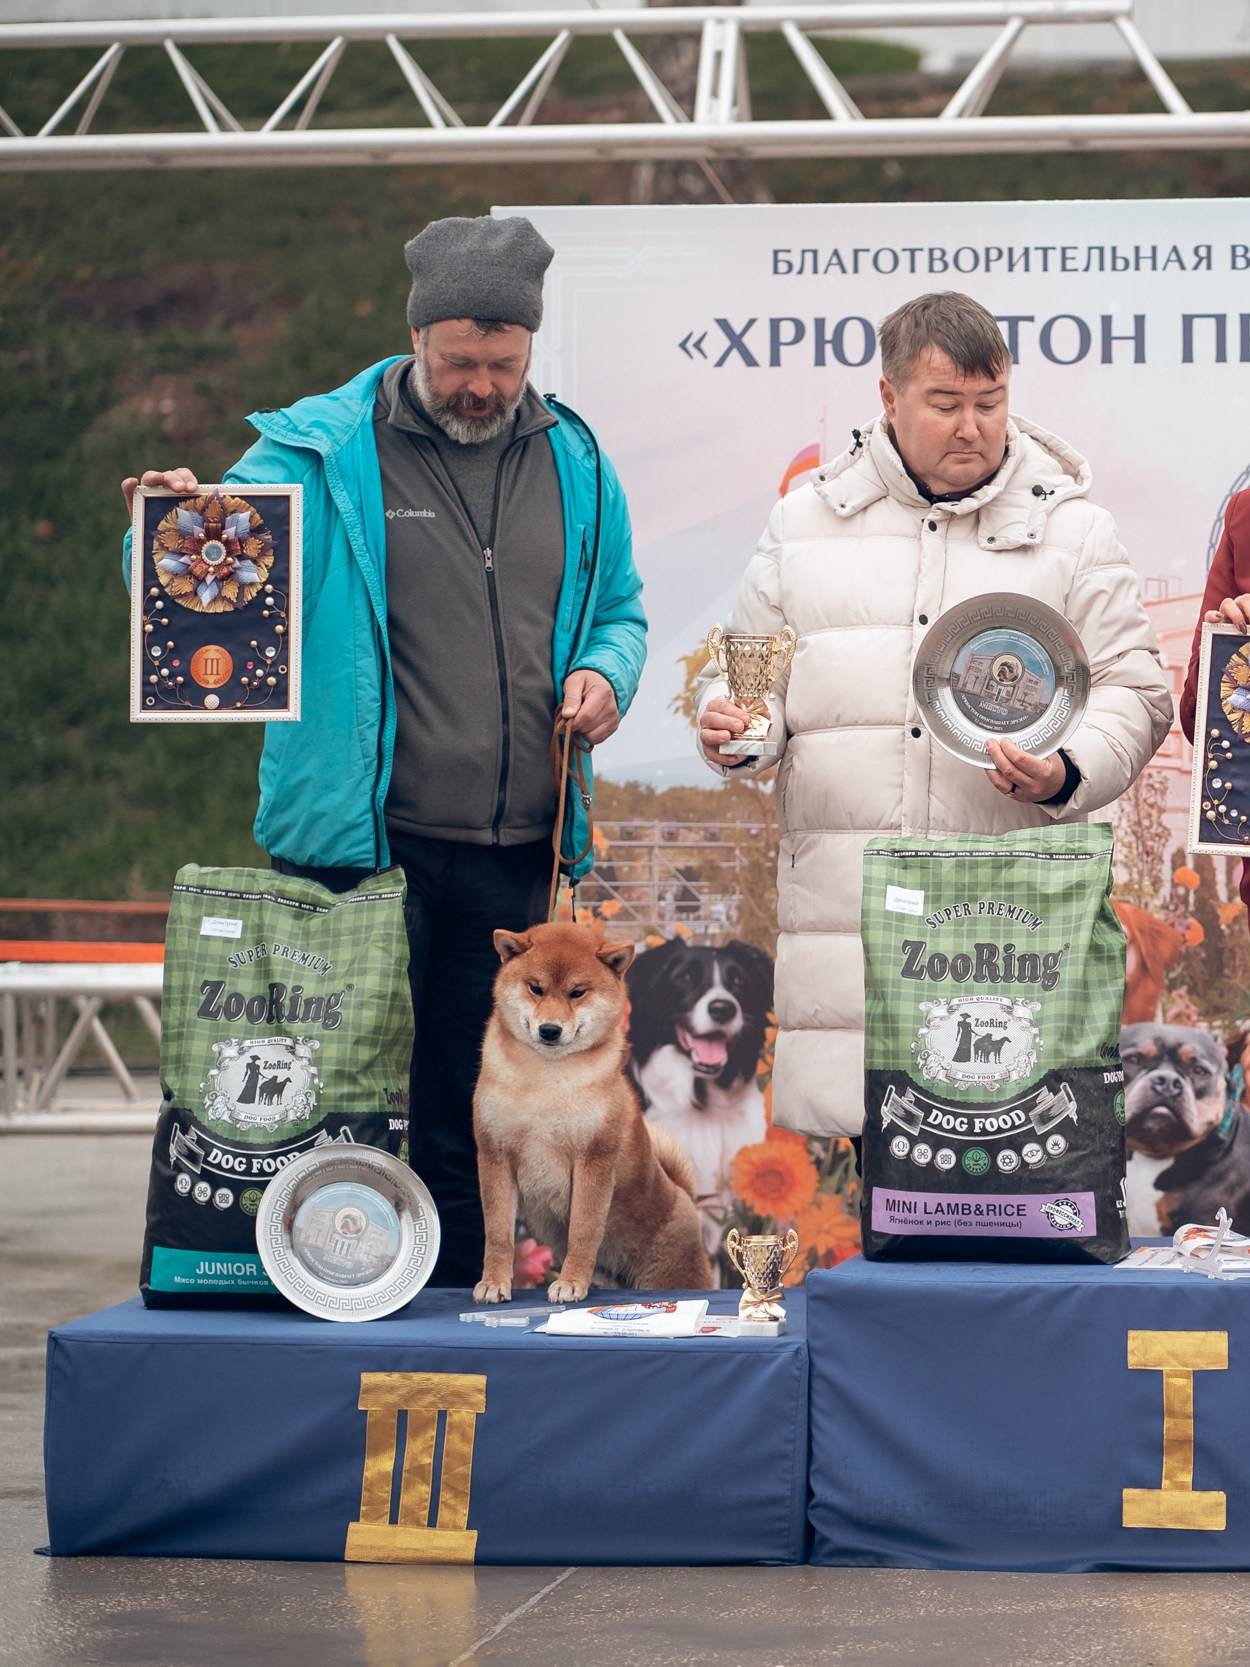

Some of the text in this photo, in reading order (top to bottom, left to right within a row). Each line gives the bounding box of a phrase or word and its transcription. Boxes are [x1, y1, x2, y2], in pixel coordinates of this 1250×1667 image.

[771, 243, 1213, 276] БЛАГОТВОРИТЕЛЬНАЯ
[678, 314, 1147, 368] «ХРЮТОН
[396, 508, 436, 518] Columbia
[925, 901, 1043, 931] SUPER PREMIUM
[227, 943, 332, 976] SUPER PREMIUM
[901, 939, 1064, 991] ZooRing
[197, 979, 346, 1030] ZooRing
[974, 1018, 1008, 1030] ZooRing
[262, 1060, 292, 1071] ZooRing
[926, 1109, 1026, 1133] DOG FOOD
[207, 1148, 247, 1172] DOG
[885, 1198, 1027, 1217] MINI LAMB&RICE
[889, 1215, 924, 1226] Ягнёнок
[935, 1220, 951, 1228] рис
[954, 1219, 973, 1228] (без
[975, 1220, 1023, 1229] пшеницы)
[195, 1261, 257, 1276] JUNIOR
[174, 1276, 269, 1286] Мясо молодых бычков
[1122, 1329, 1229, 1531] I
[344, 1371, 488, 1565] III
